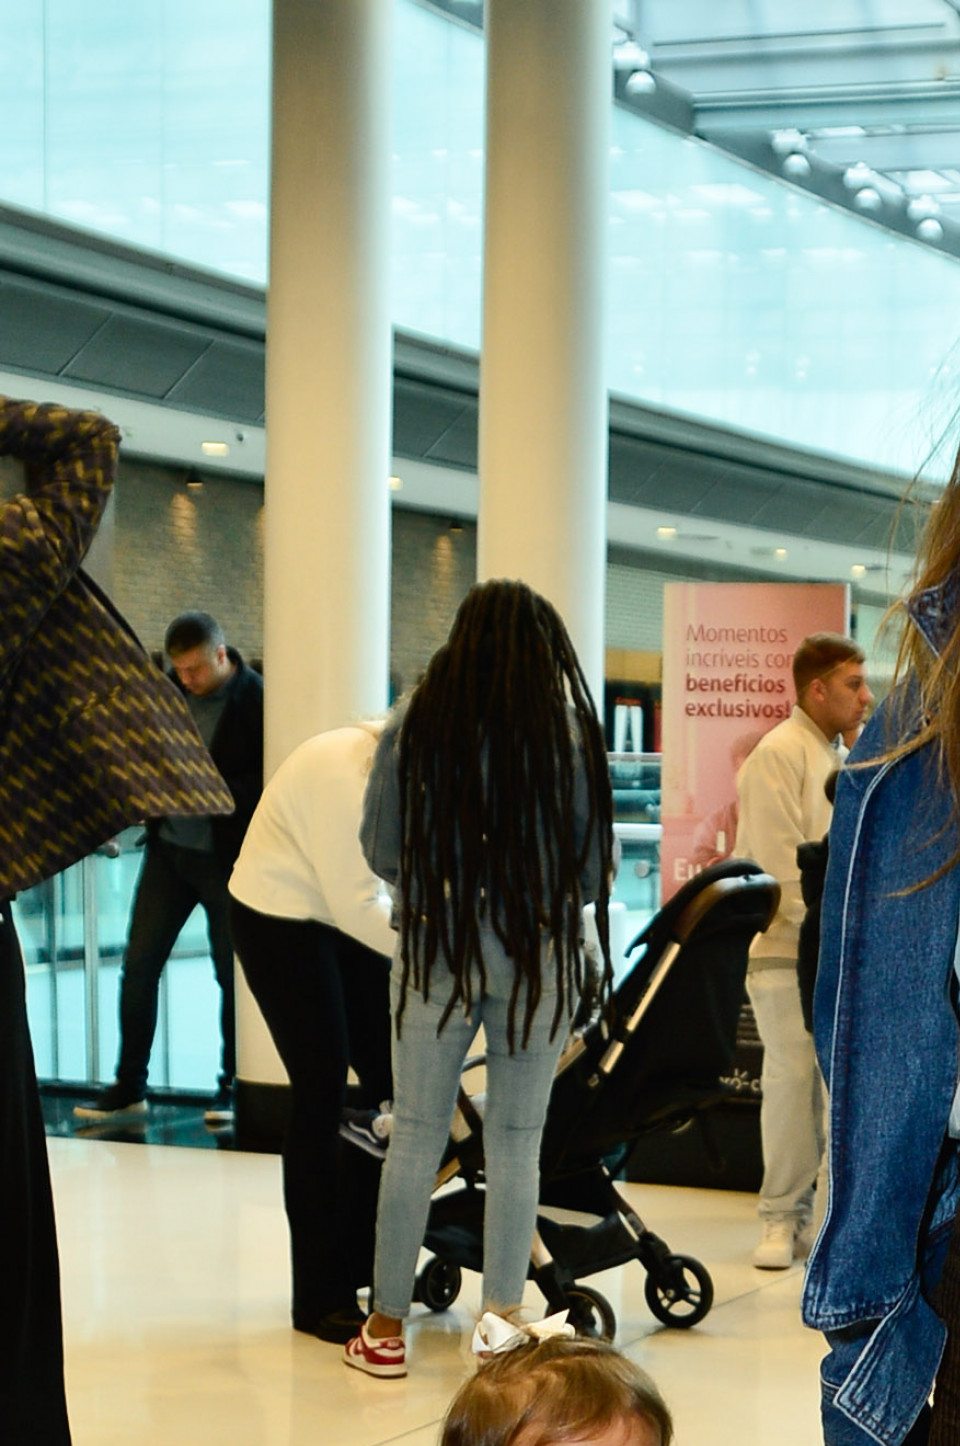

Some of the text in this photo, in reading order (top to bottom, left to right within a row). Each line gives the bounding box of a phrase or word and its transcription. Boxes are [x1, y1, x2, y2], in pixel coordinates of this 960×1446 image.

[686, 624, 788, 643] Momentos
[686, 647, 760, 668] incríveis
[685, 673, 786, 693] benefícios
[685, 697, 791, 719] exclusivos!
